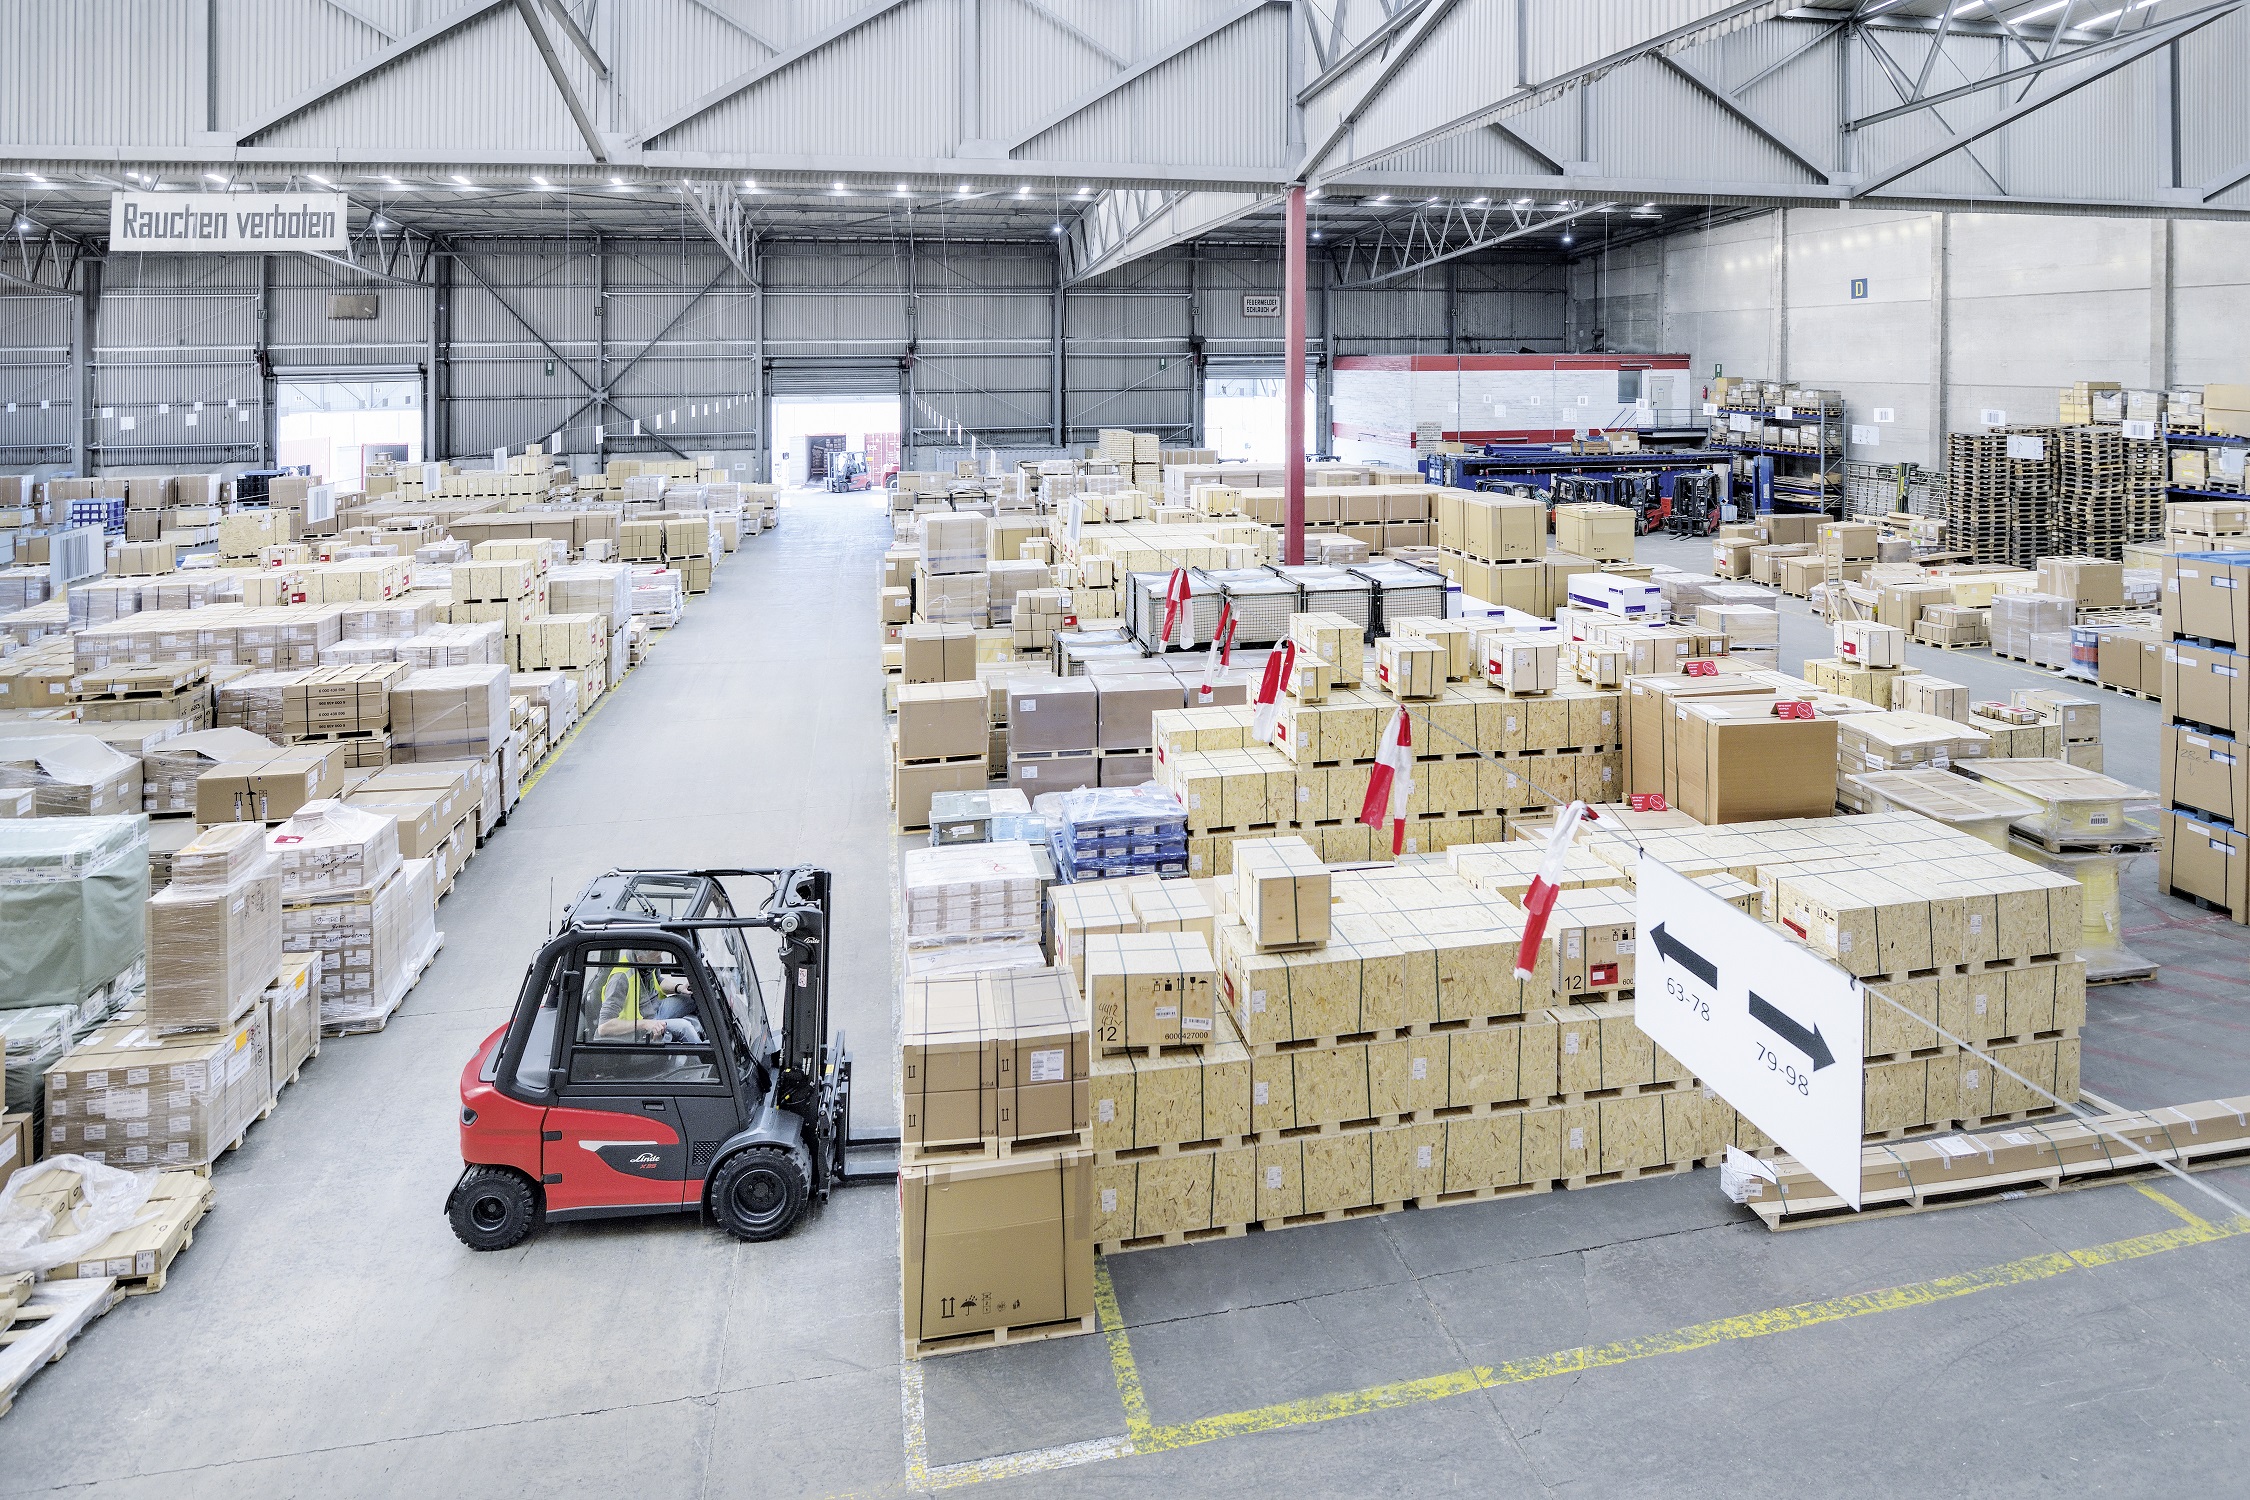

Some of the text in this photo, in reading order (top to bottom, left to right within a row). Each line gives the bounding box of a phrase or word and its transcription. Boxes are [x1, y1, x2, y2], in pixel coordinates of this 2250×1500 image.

[122, 202, 336, 239] Rauchen verboten
[1855, 281, 1864, 297] D
[258, 310, 266, 318] 17
[596, 307, 603, 316] 18
[1564, 975, 1582, 990] 12
[1666, 977, 1710, 1022] 63-78
[1097, 1026, 1208, 1042] 12 6000427000
[1756, 1041, 1809, 1096] 79-98
[630, 1152, 660, 1162] Linde
